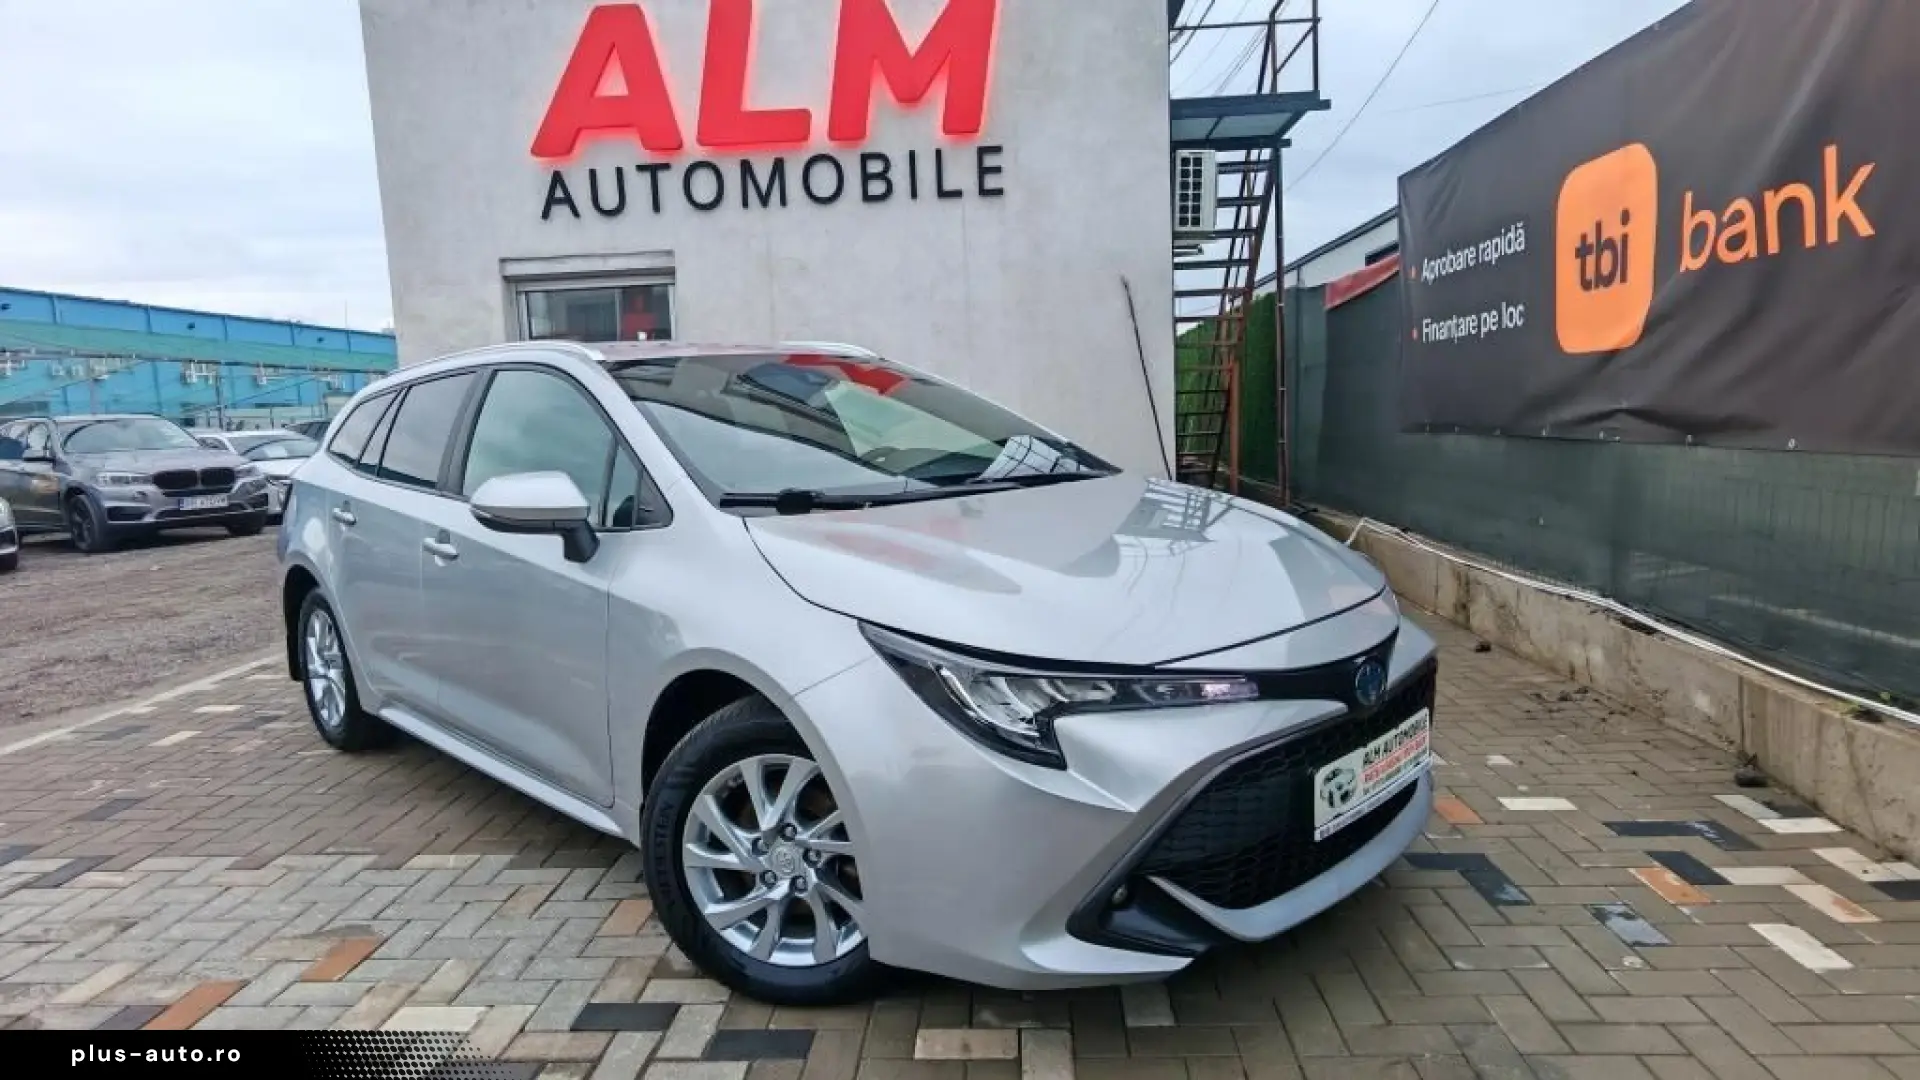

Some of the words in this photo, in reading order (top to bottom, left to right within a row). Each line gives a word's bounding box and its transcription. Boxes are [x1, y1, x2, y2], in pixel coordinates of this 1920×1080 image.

[531, 0, 997, 157] ALM
[541, 146, 1004, 219] AUTOMOBILE
[1575, 208, 1630, 292] tbi
[1679, 144, 1876, 273] bank
[1421, 246, 1477, 285] Aprobare
[1479, 221, 1526, 265] rapidă
[1480, 309, 1499, 338] pe
[1501, 301, 1526, 329] loc
